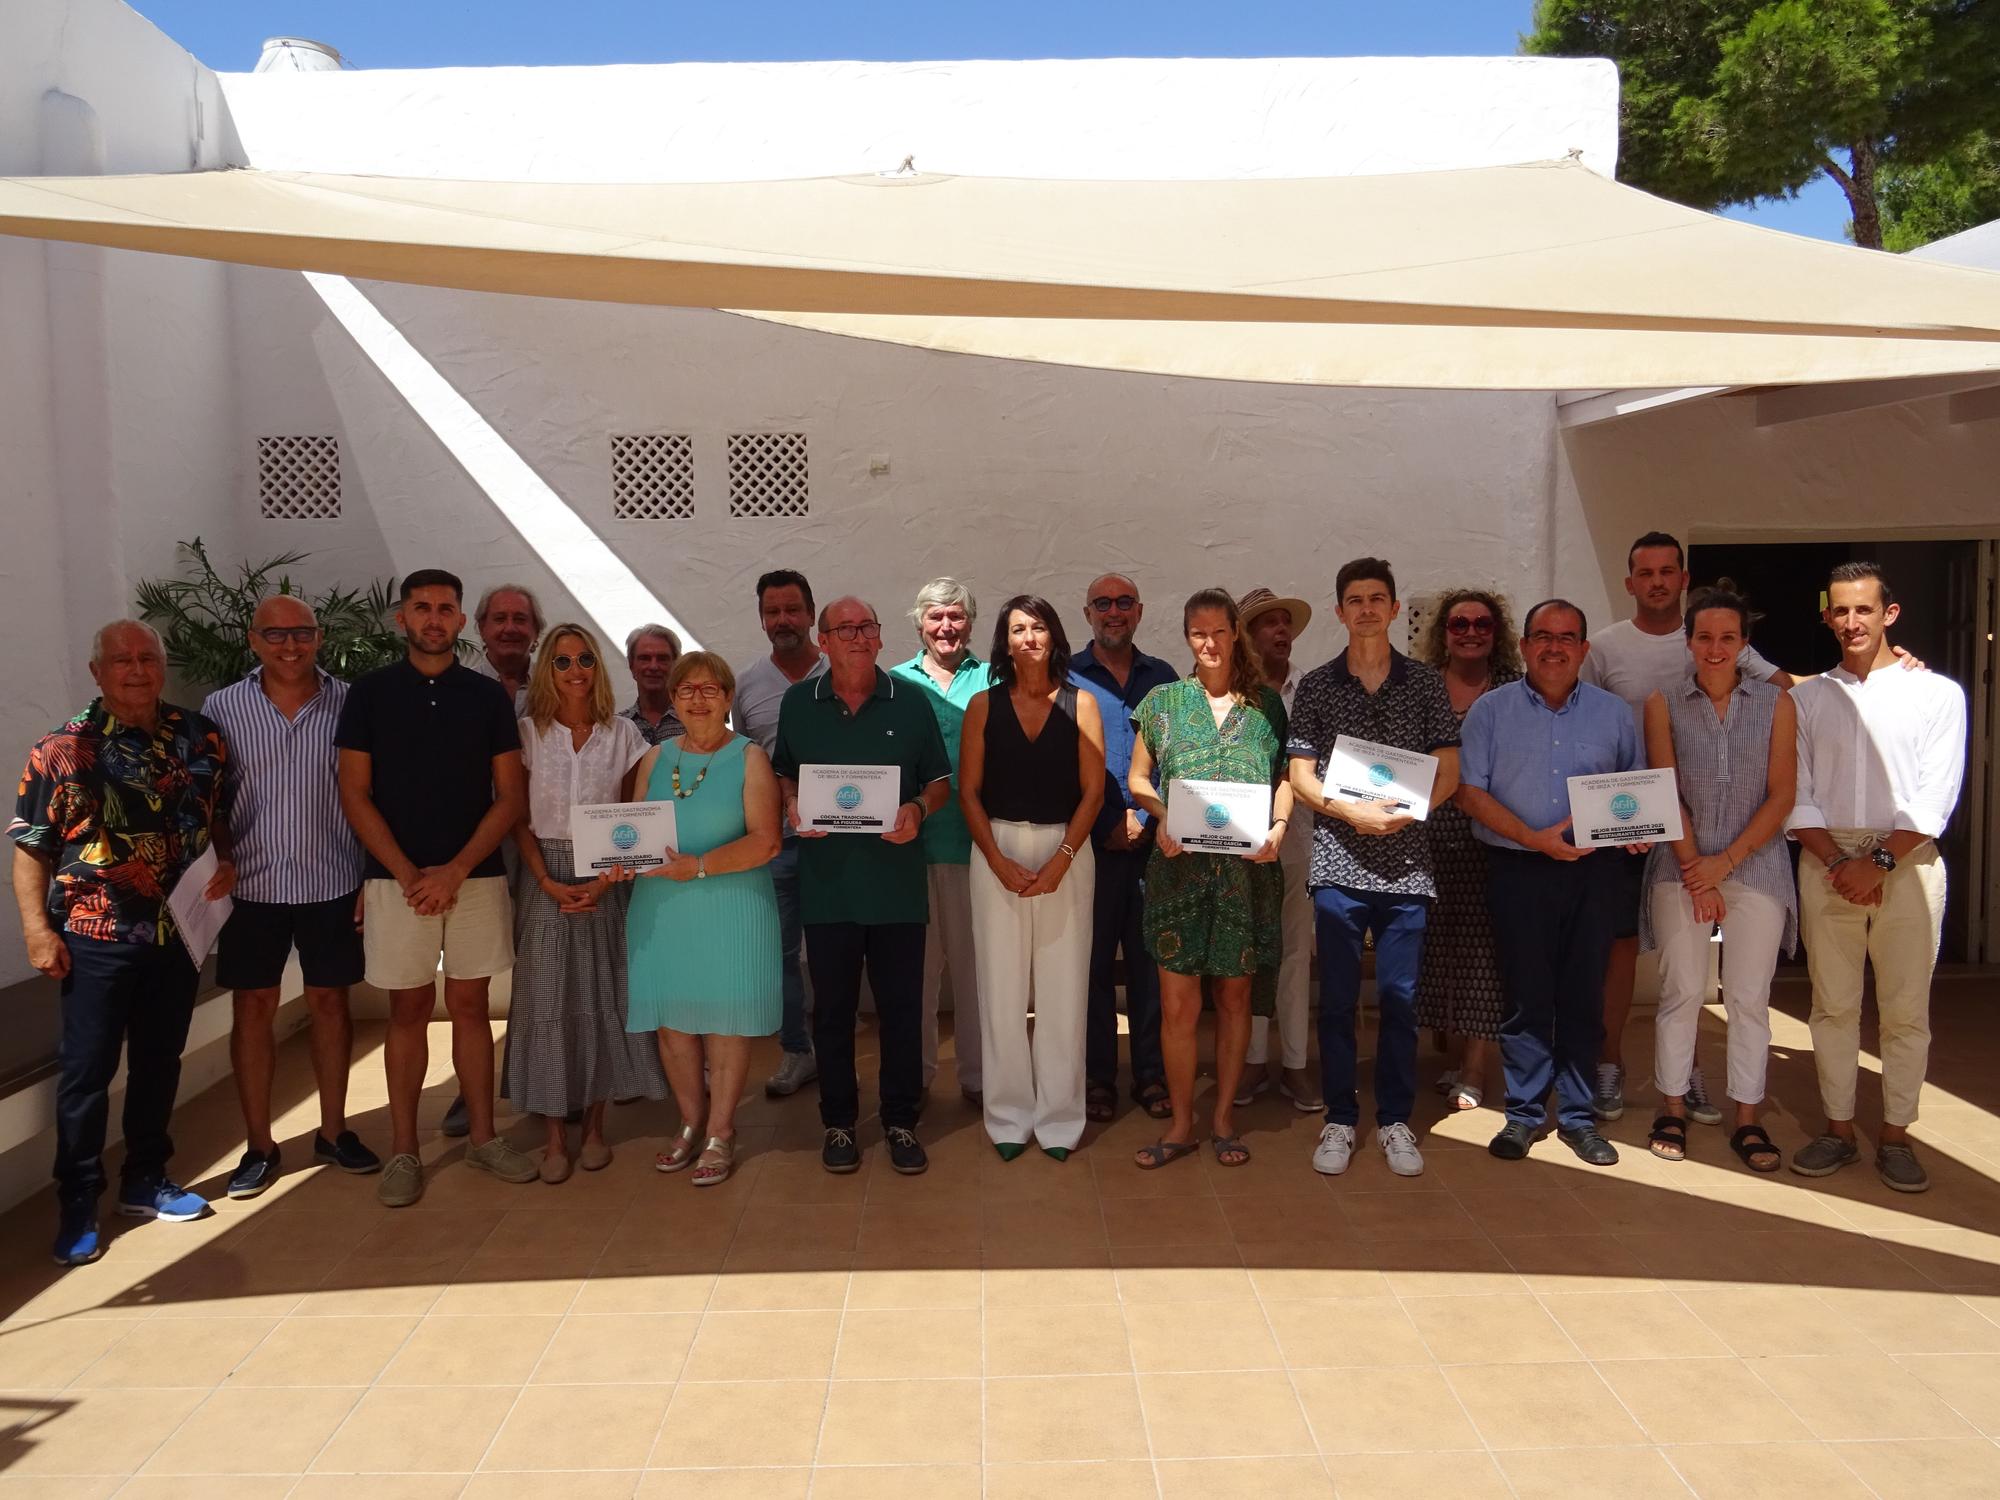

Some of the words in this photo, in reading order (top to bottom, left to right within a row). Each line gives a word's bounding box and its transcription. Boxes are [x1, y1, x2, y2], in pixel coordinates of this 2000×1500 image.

[1348, 742, 1376, 752] ACADEMIA
[1381, 754, 1417, 766] FORMENTERA
[1598, 831, 1635, 839] RESTAURANTE
